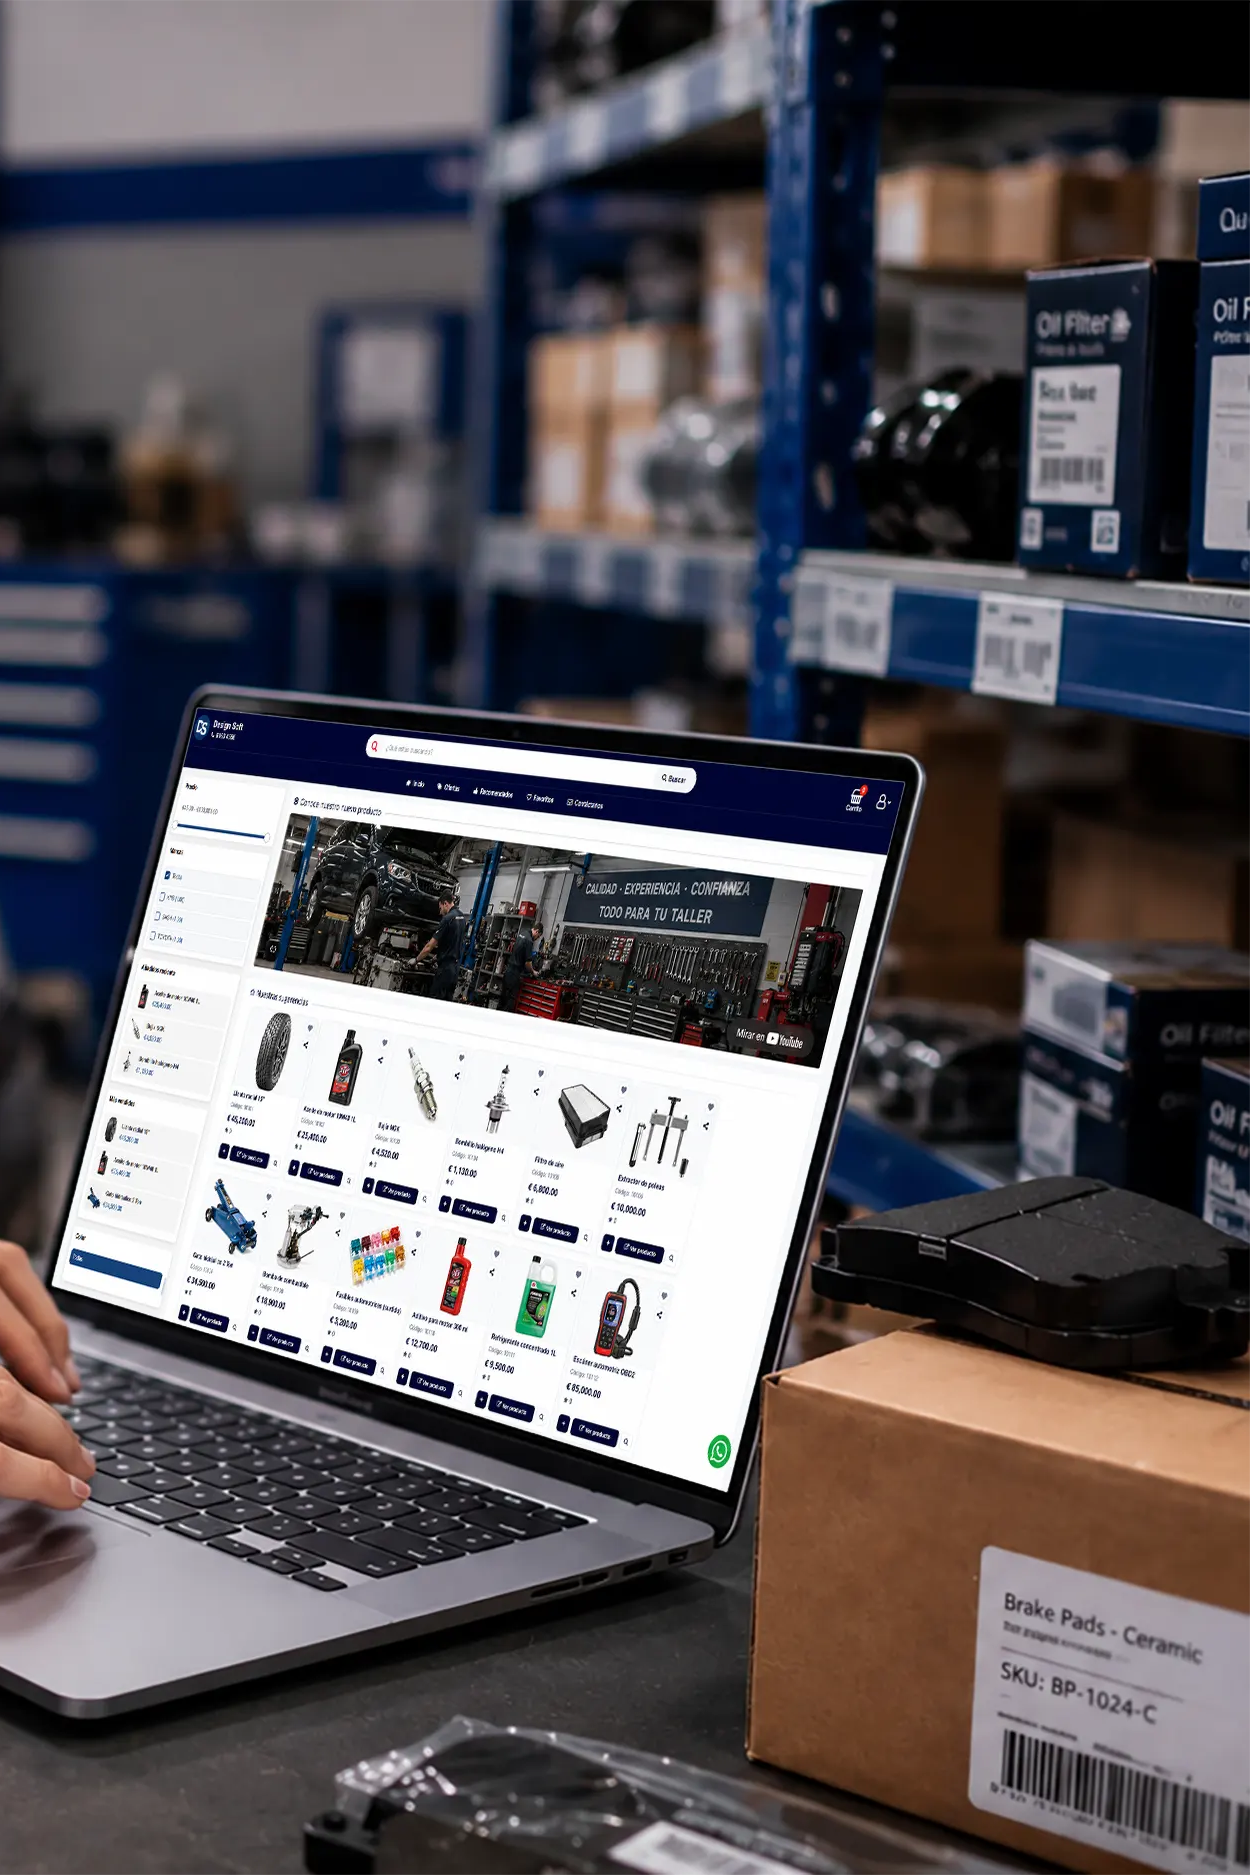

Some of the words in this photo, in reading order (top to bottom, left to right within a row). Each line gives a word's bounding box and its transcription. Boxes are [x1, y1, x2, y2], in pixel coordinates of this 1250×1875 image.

[1220, 207, 1250, 233] Qu
[1213, 297, 1238, 322] Oil
[1035, 310, 1061, 339] Oil
[1064, 309, 1110, 336] Filter
[196, 720, 208, 735] DS
[213, 720, 232, 731] Design
[232, 722, 244, 730] Soft
[668, 775, 686, 783] Buscar
[480, 788, 513, 798] Recomendados
[533, 794, 554, 803] Favoritos
[300, 798, 320, 808] Conoce
[357, 807, 382, 816] producto
[845, 804, 863, 813] Carrito
[585, 881, 618, 896] CALIDAD
[624, 882, 681, 896] EXPERIENCIA
[690, 881, 750, 896] CONFIANZA
[599, 905, 623, 919] TODO
[624, 907, 651, 921] PARA
[653, 908, 667, 922] TU
[671, 908, 713, 924] TALLER
[257, 990, 278, 1000] Nuestras
[736, 1028, 756, 1040] Mirar
[756, 1033, 765, 1042] en
[779, 1034, 804, 1049] YouTube
[1210, 1100, 1235, 1128] Oil
[618, 1174, 640, 1185] Extractor
[648, 1182, 664, 1191] poleas
[491, 1333, 520, 1346] Refrigerante
[573, 1355, 593, 1366] Escáner
[1005, 1592, 1056, 1622] Brake
[1061, 1608, 1105, 1637] Pads
[1123, 1625, 1204, 1665] Ceramic
[1000, 1661, 1045, 1691] SKU:
[1051, 1676, 1158, 1725] BP-1024-C
